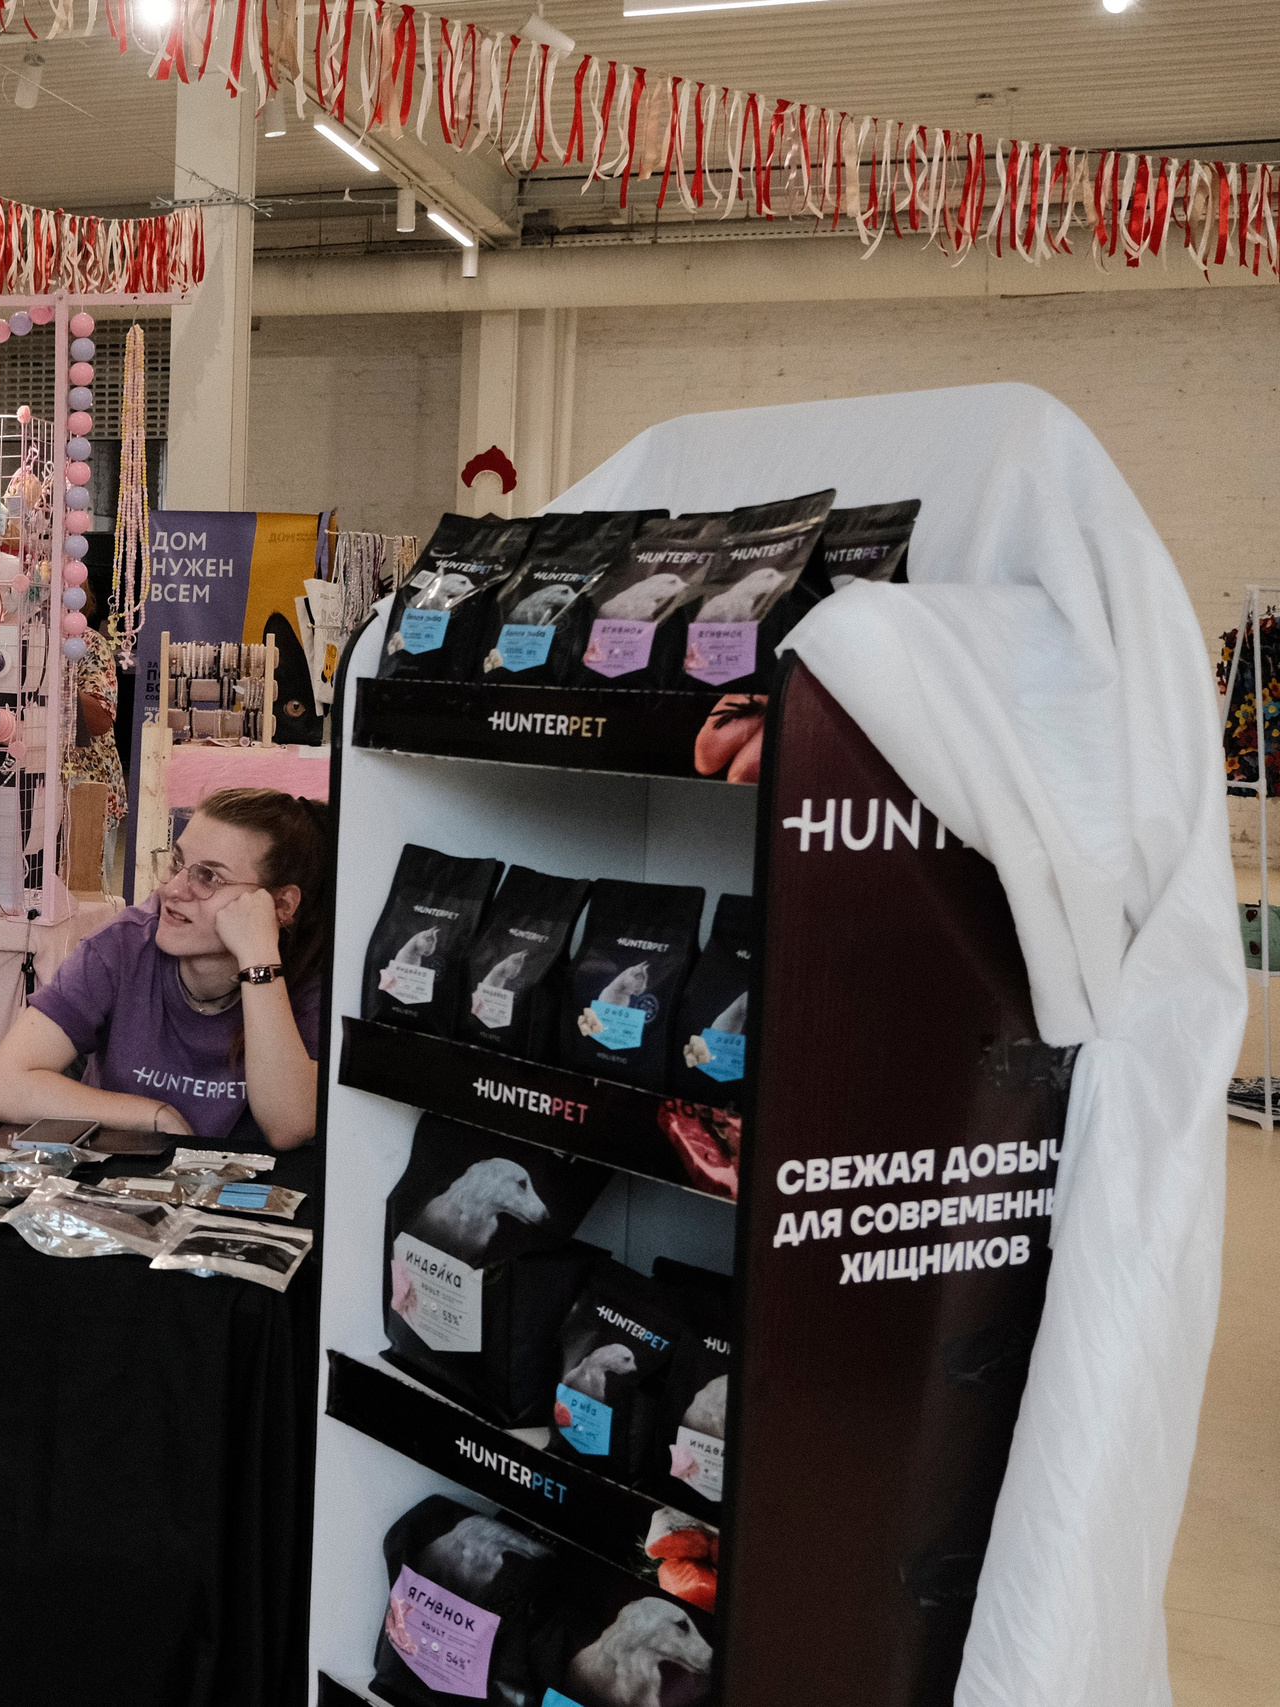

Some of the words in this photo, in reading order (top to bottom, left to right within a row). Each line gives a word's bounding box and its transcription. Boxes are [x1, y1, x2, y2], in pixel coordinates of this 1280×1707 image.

[152, 531, 207, 553] ДОМ
[636, 550, 715, 564] HUNTERPET
[824, 545, 890, 563] NTERPET
[152, 557, 234, 578] НУЖЕН
[150, 583, 210, 603] ВСЕМ
[487, 710, 608, 739] HUNTERPET
[782, 798, 976, 852] HUN
[617, 937, 670, 953] HUNTERPET
[133, 1066, 247, 1100] HUNTERPET
[472, 1077, 590, 1124] HUNTERPET
[776, 1148, 935, 1195] СВЕЖАЯ
[773, 1208, 843, 1249] ДЛЯ
[838, 1234, 1030, 1285] ХИЩНИКОВ
[596, 1305, 670, 1352] HUNTERPET
[455, 1436, 568, 1504] HUNTERPET
